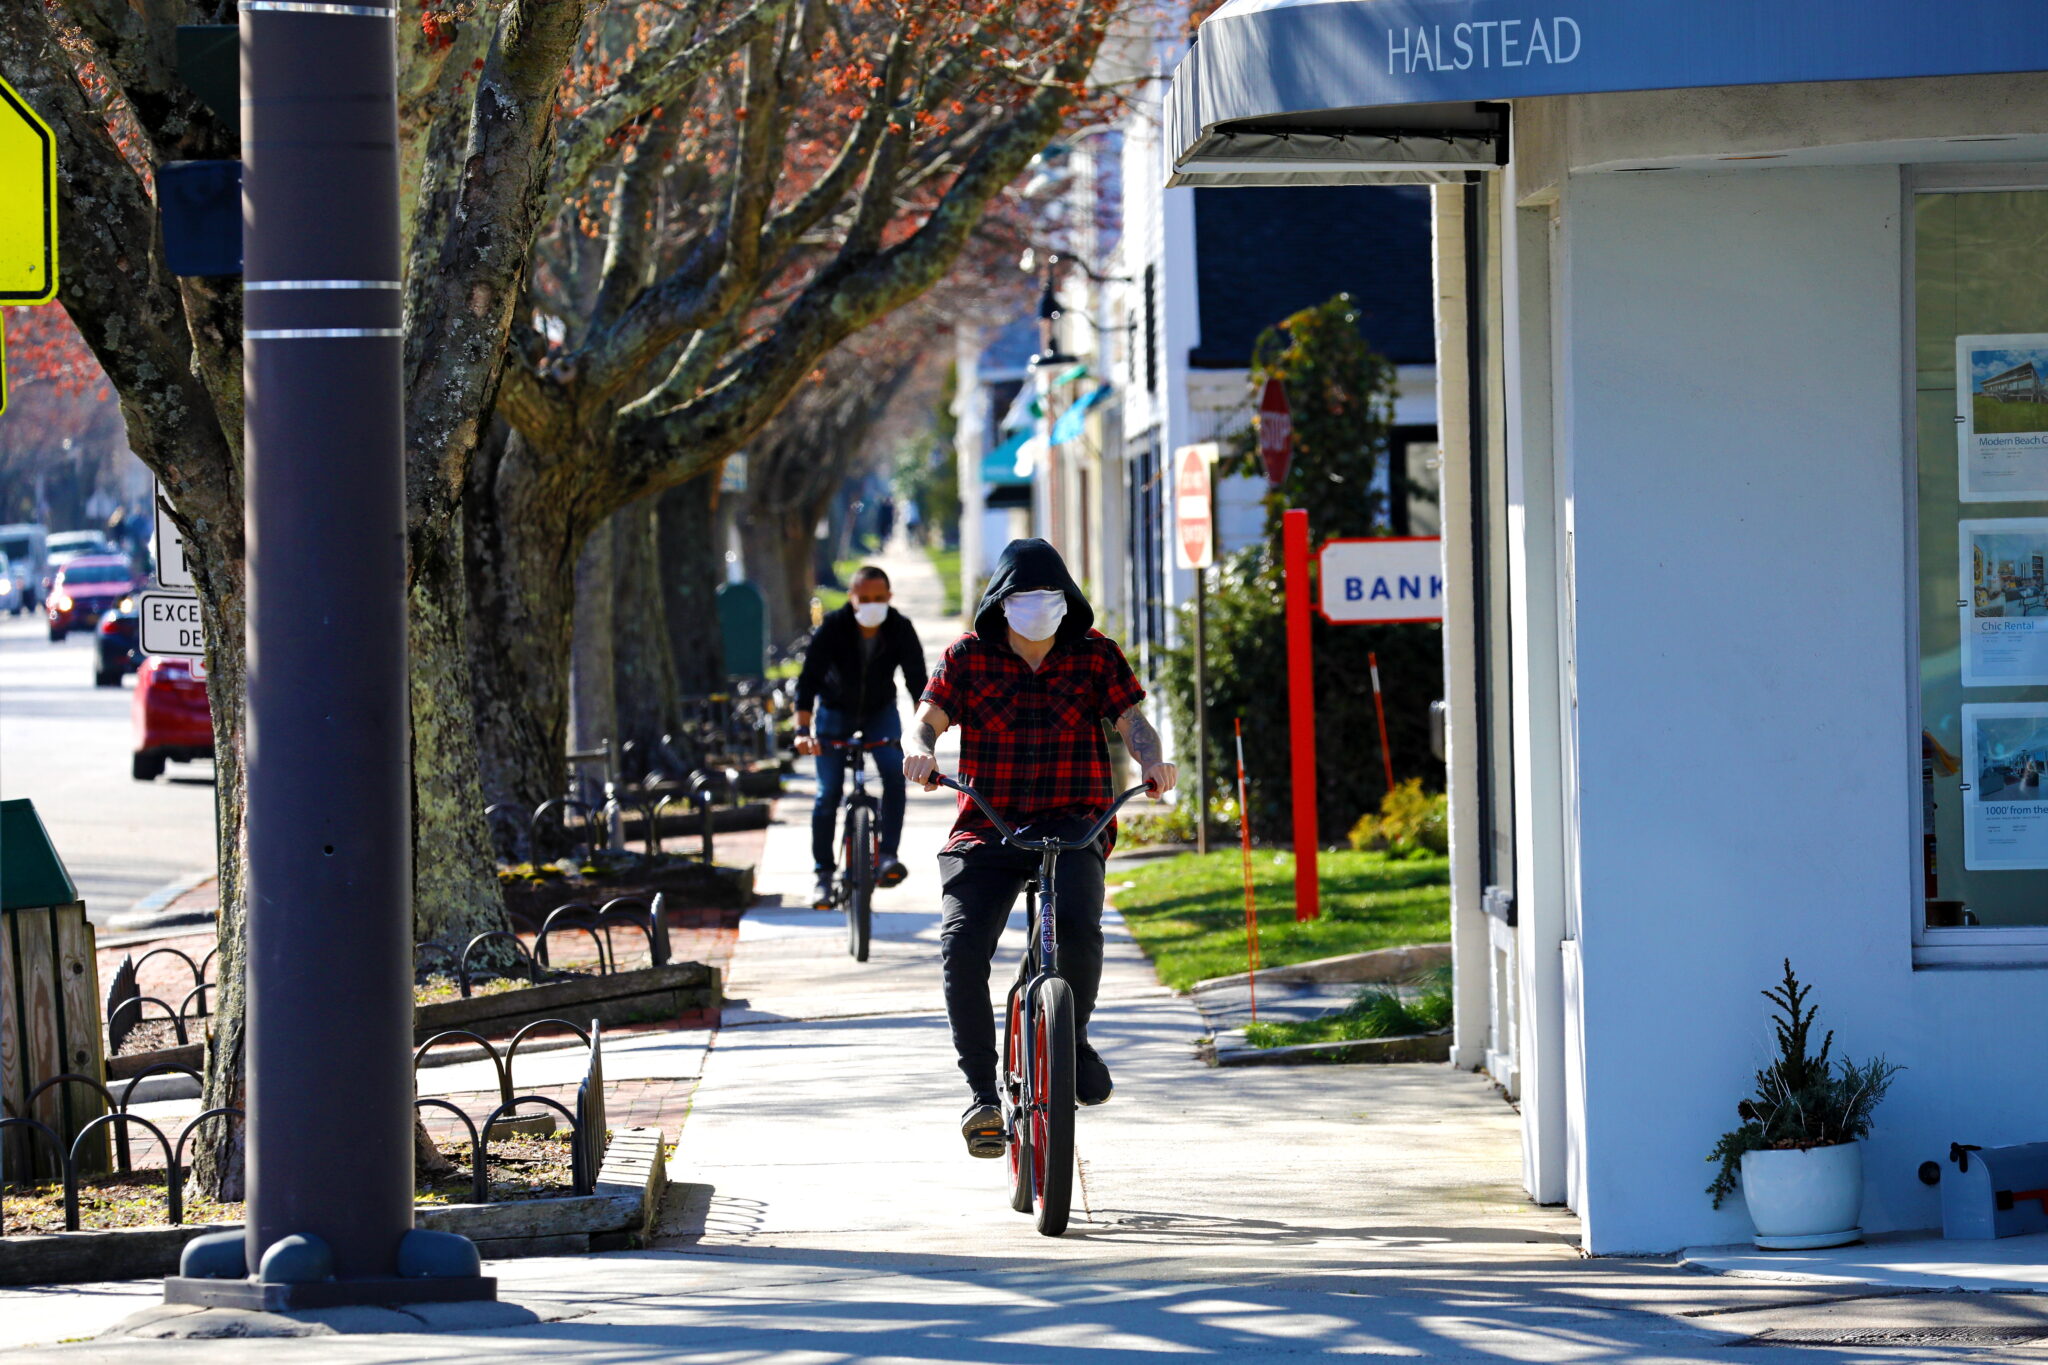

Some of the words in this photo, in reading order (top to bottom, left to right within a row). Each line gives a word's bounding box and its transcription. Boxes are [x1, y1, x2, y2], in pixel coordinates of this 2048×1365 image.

[1388, 16, 1581, 75] HALSTEAD
[1979, 437, 2013, 446] Modern
[2014, 436, 2041, 445] Beach
[1345, 575, 1442, 601] BANK
[1981, 621, 2002, 631] Chic
[2004, 620, 2034, 631] Rental
[2010, 805, 2032, 815] from
